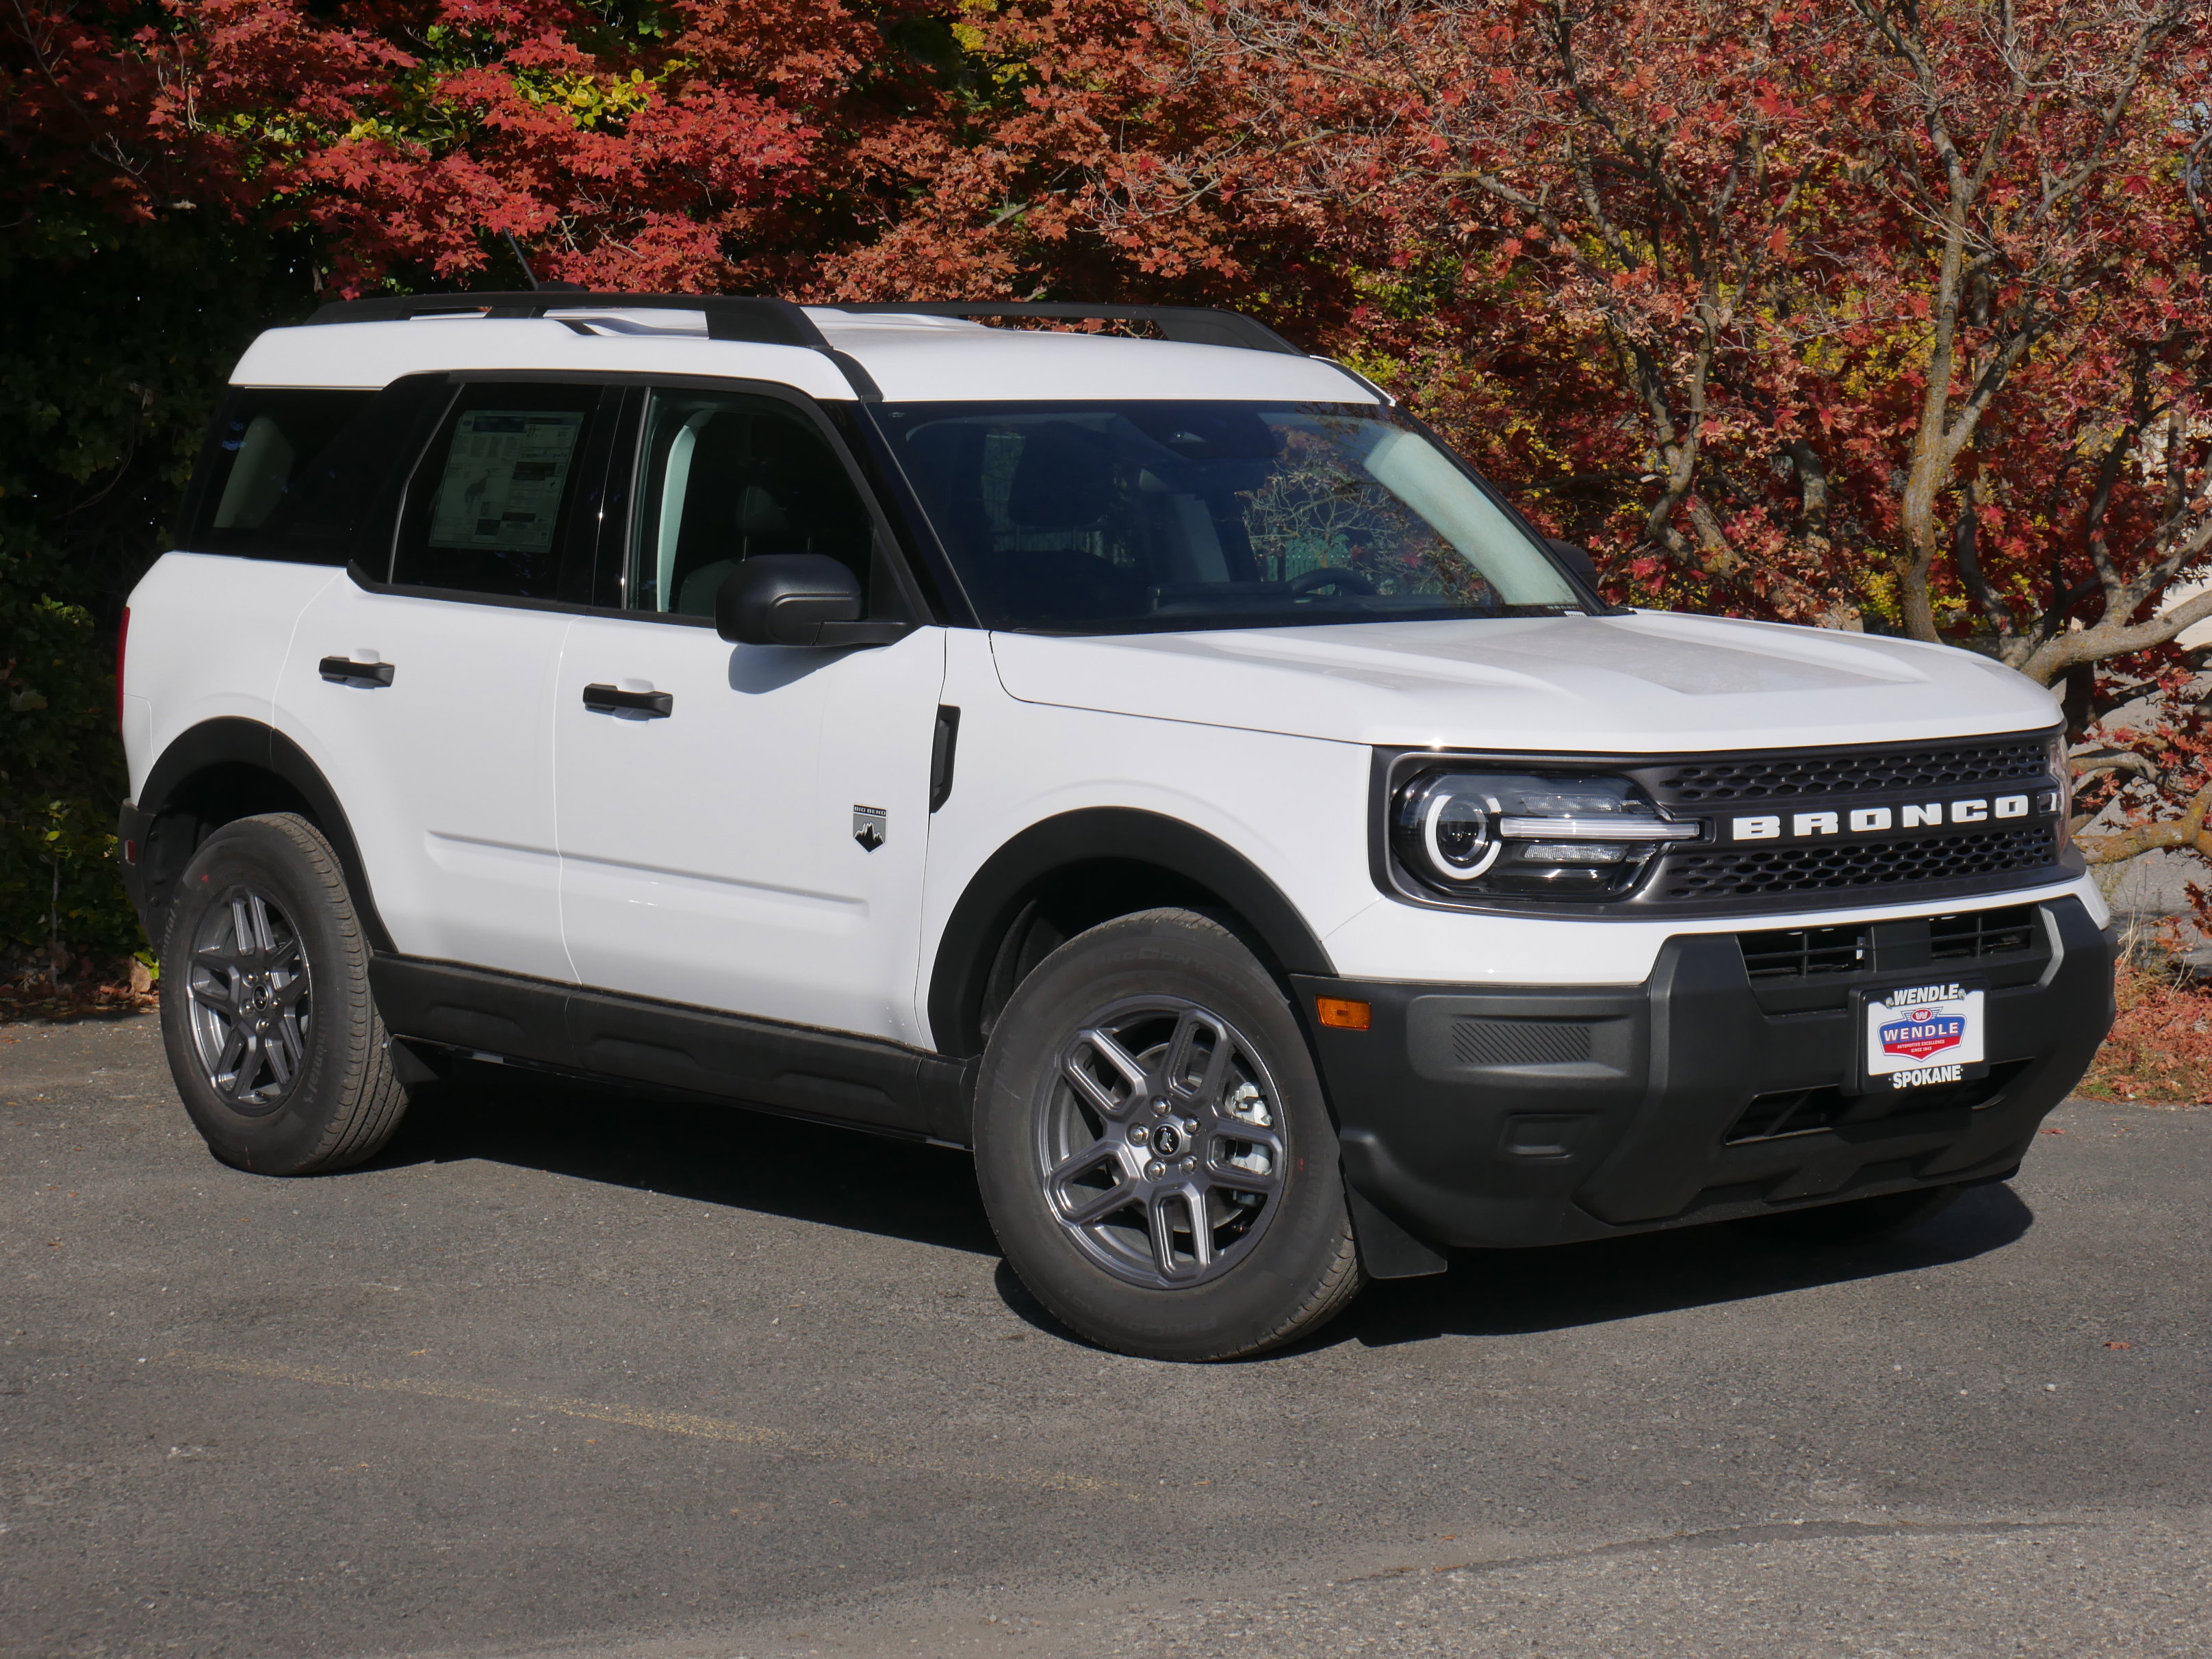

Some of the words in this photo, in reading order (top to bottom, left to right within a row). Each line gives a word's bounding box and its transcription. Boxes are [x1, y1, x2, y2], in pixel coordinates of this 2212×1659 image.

[1733, 795, 2029, 840] BRONCO
[1894, 983, 1959, 1006] WENDLE
[1883, 1022, 1959, 1042] WENDLE
[1893, 1064, 1962, 1089] SPOKANE
